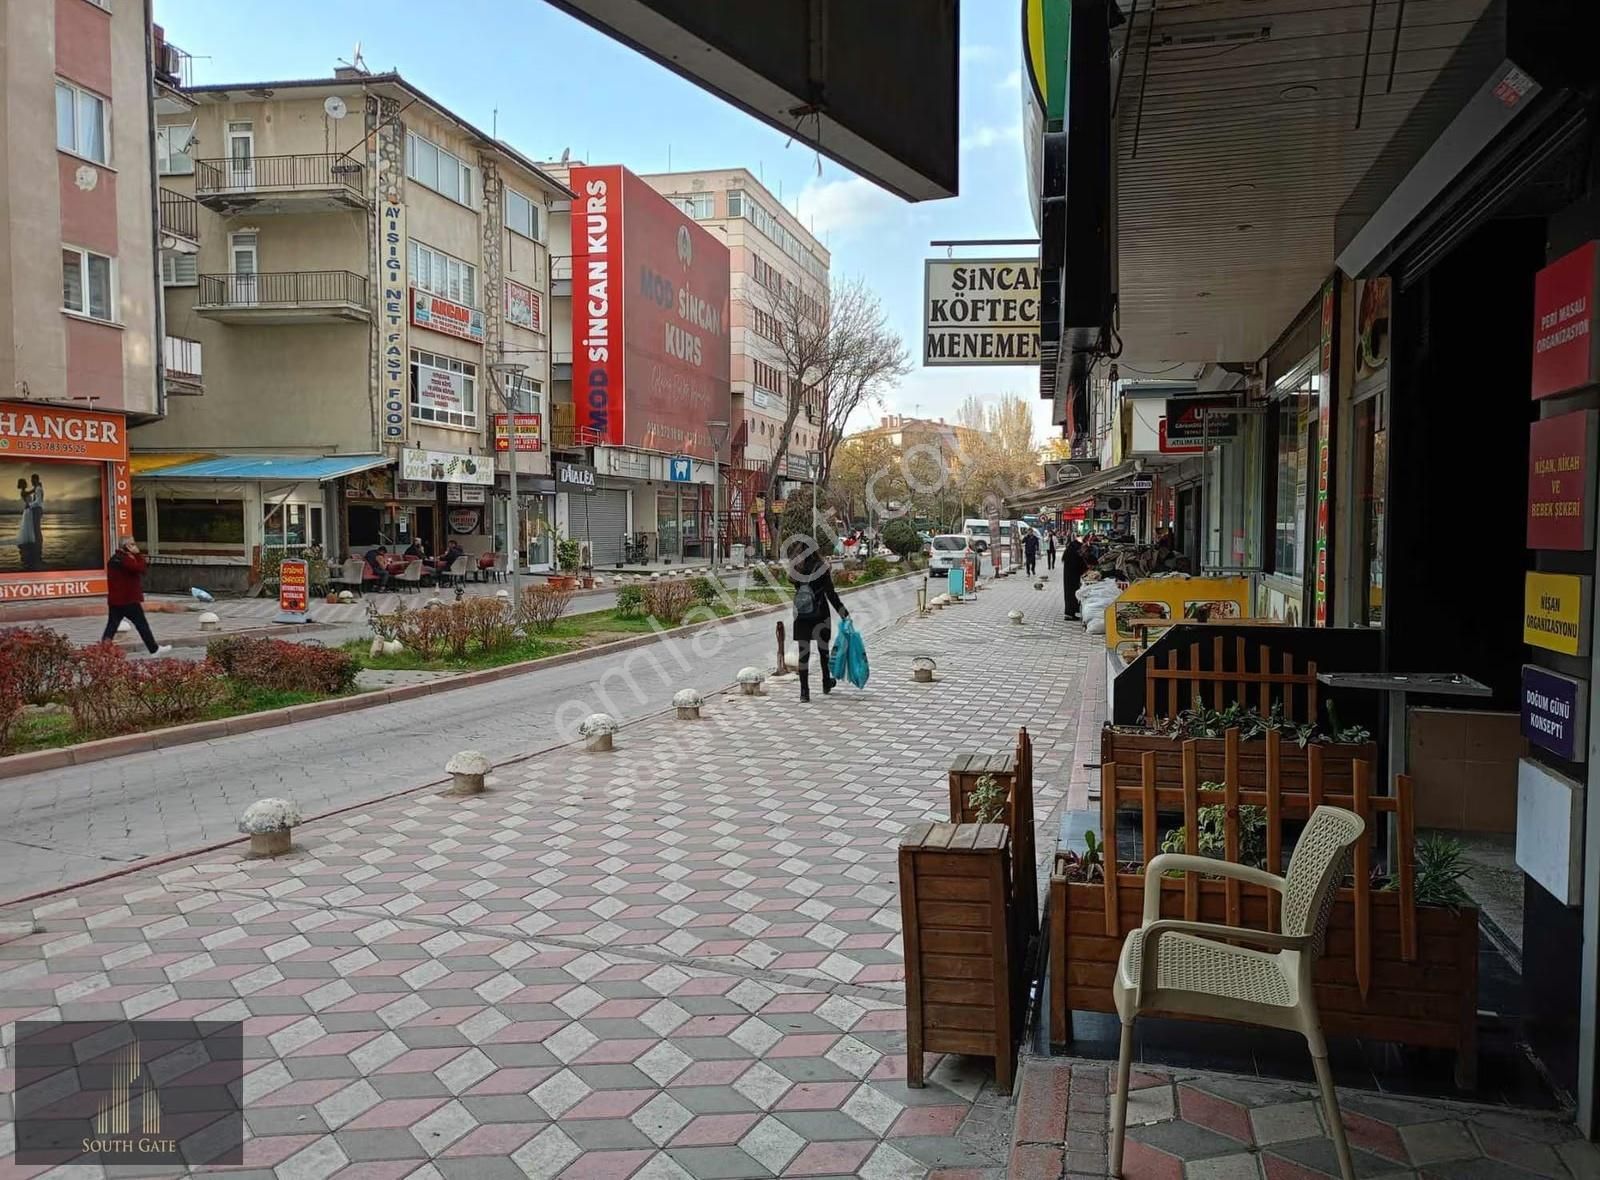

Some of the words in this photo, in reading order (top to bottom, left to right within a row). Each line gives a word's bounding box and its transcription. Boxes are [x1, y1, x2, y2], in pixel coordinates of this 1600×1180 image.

[586, 180, 608, 254] KURS
[385, 289, 401, 325] NET
[582, 262, 608, 363] SİNCAN
[386, 334, 401, 381] FAST
[665, 321, 702, 367] KURS
[386, 389, 402, 436] FOOD
[588, 367, 608, 433] MOD
[1532, 502, 1553, 517] BEBEK
[1551, 480, 1561, 494] VE
[1526, 690, 1549, 711] DOĞUM
[1550, 697, 1570, 719] GÜNÜ
[1530, 713, 1564, 739] KONSEPTİ
